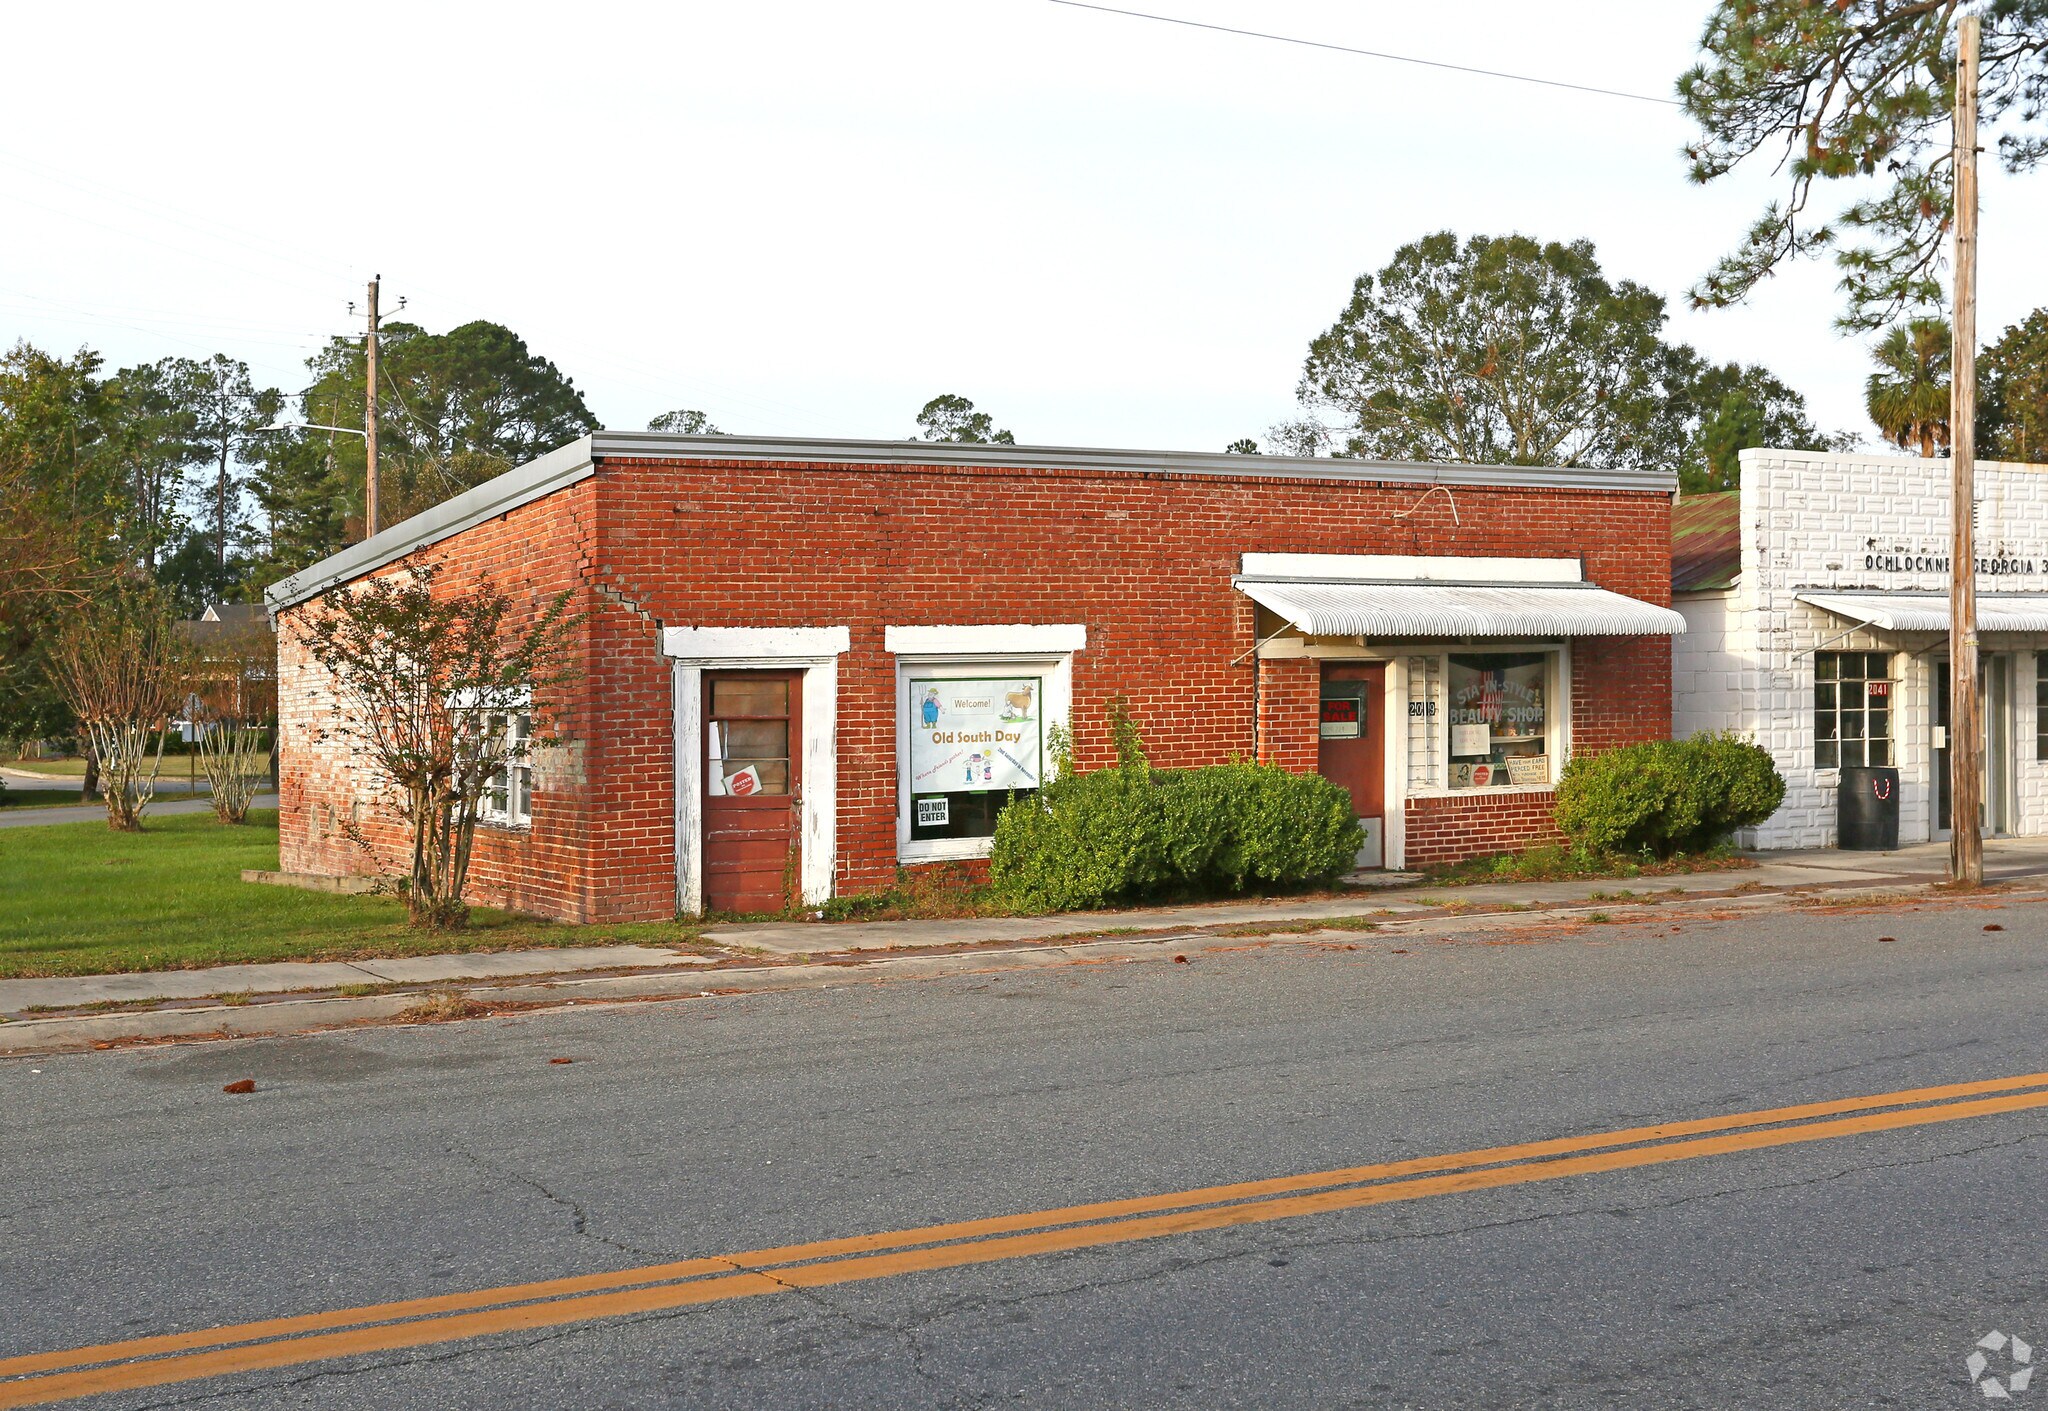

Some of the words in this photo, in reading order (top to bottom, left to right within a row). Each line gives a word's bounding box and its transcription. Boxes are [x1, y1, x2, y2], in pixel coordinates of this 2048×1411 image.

[1865, 555, 1950, 572] OCHLOCKNE
[1869, 684, 1887, 695] 2041
[954, 699, 991, 708] Welcome!
[1327, 702, 1350, 711] FOR
[1409, 703, 1435, 715] 209
[1323, 711, 1357, 721] SALE
[1449, 707, 1502, 724] BEAUTY
[932, 731, 954, 744] Old
[957, 731, 992, 743] South
[995, 730, 1021, 743] Day
[732, 776, 751, 788] POSTED
[919, 803, 930, 812] DO
[931, 802, 946, 811] NOT
[920, 812, 946, 822] ENTER
